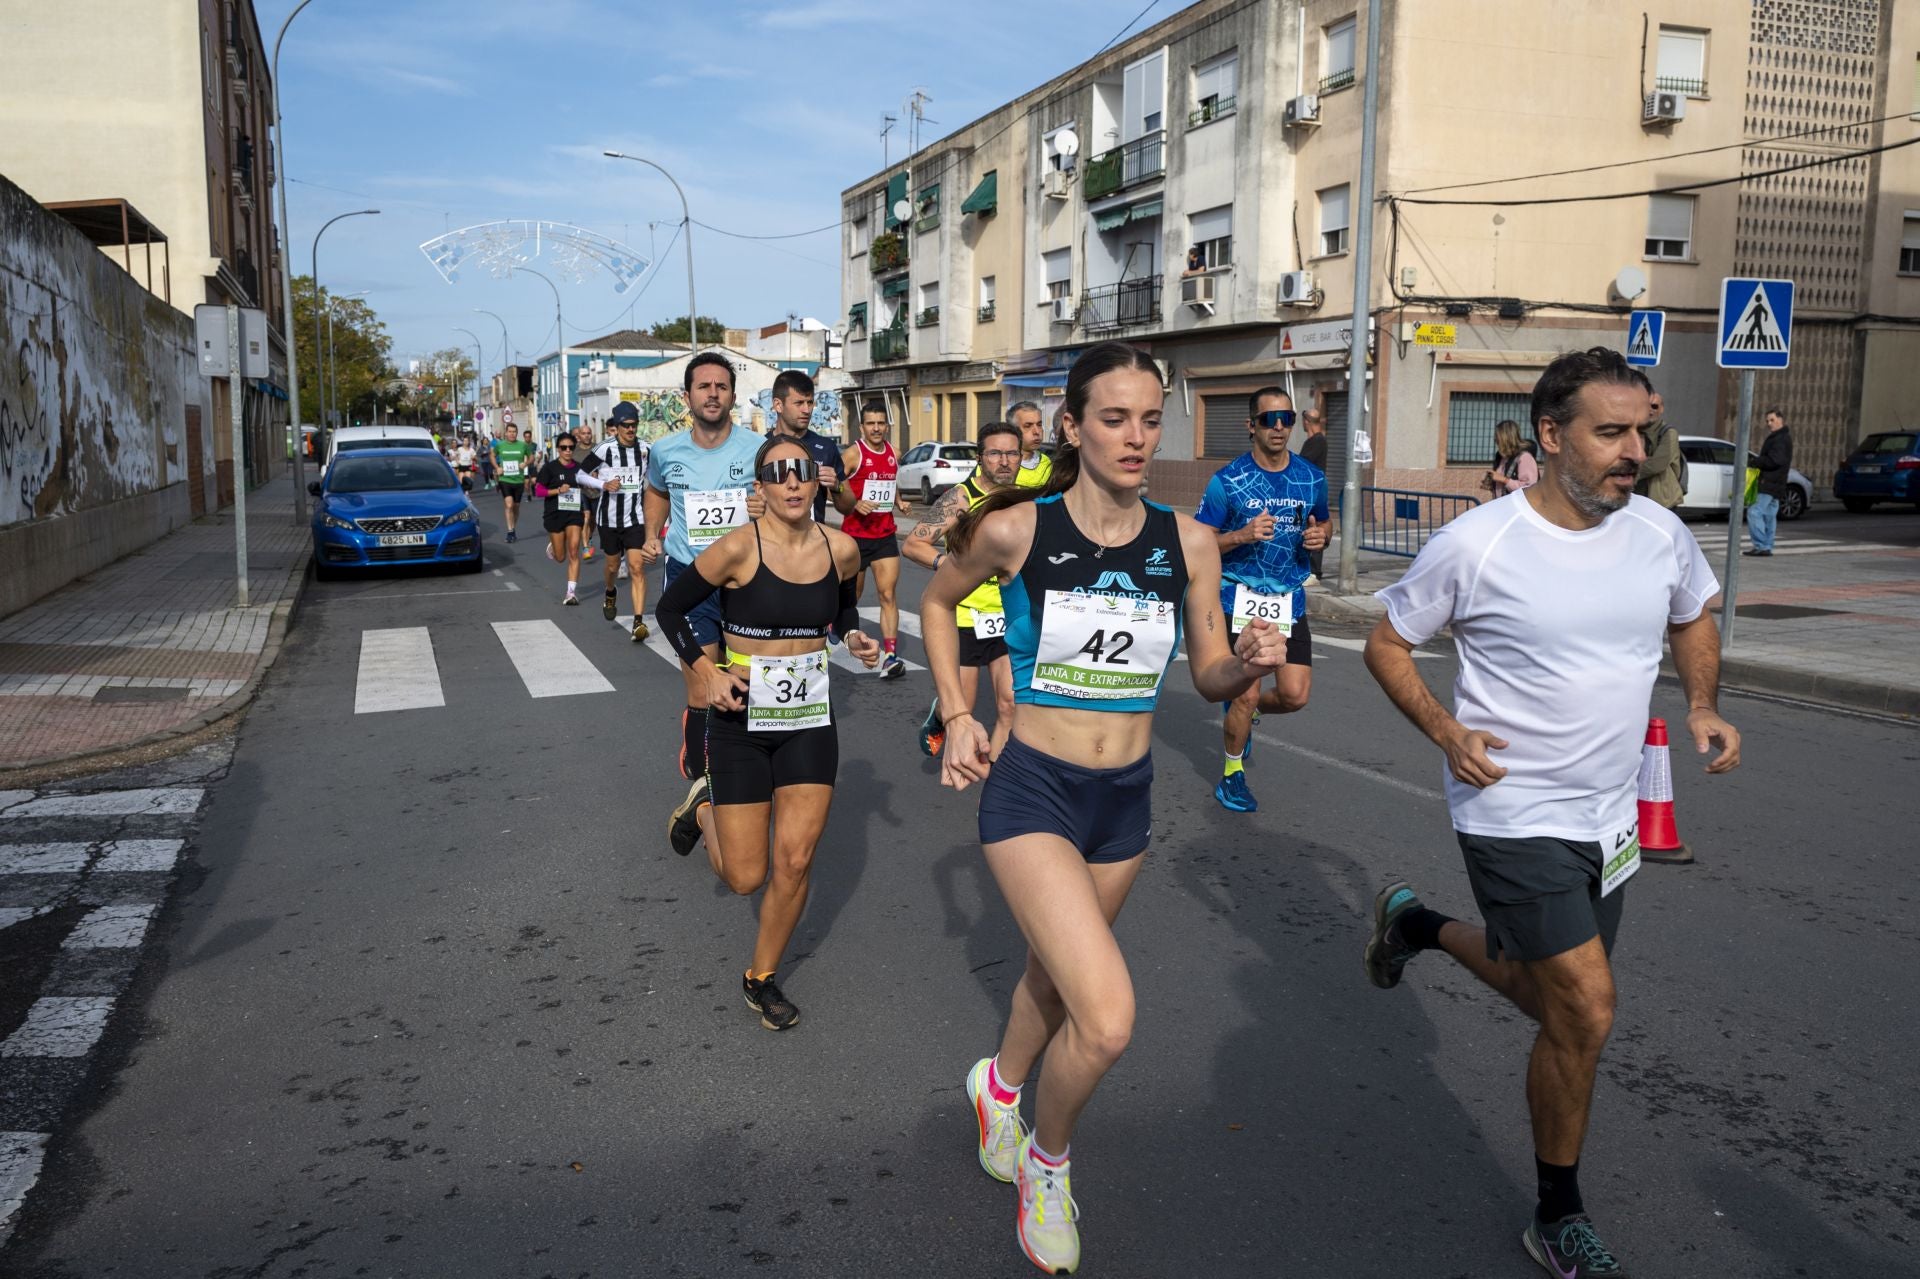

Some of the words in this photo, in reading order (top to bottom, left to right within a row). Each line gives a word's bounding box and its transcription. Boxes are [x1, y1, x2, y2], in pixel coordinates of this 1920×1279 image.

[731, 467, 743, 475] TM
[869, 490, 890, 501] 310
[697, 507, 736, 526] 237
[1245, 599, 1281, 619] 263
[728, 624, 772, 637] TRAINING
[779, 628, 819, 636] TRAINING
[1079, 629, 1134, 665] 42
[1040, 666, 1068, 679] JUNTA
[1073, 671, 1085, 682] DE
[1090, 674, 1153, 686] EXTREMADURA
[775, 678, 808, 703] 34
[752, 708, 771, 718] JUNTA
[774, 709, 782, 717] DE
[784, 705, 826, 717] EXTREMADURA
